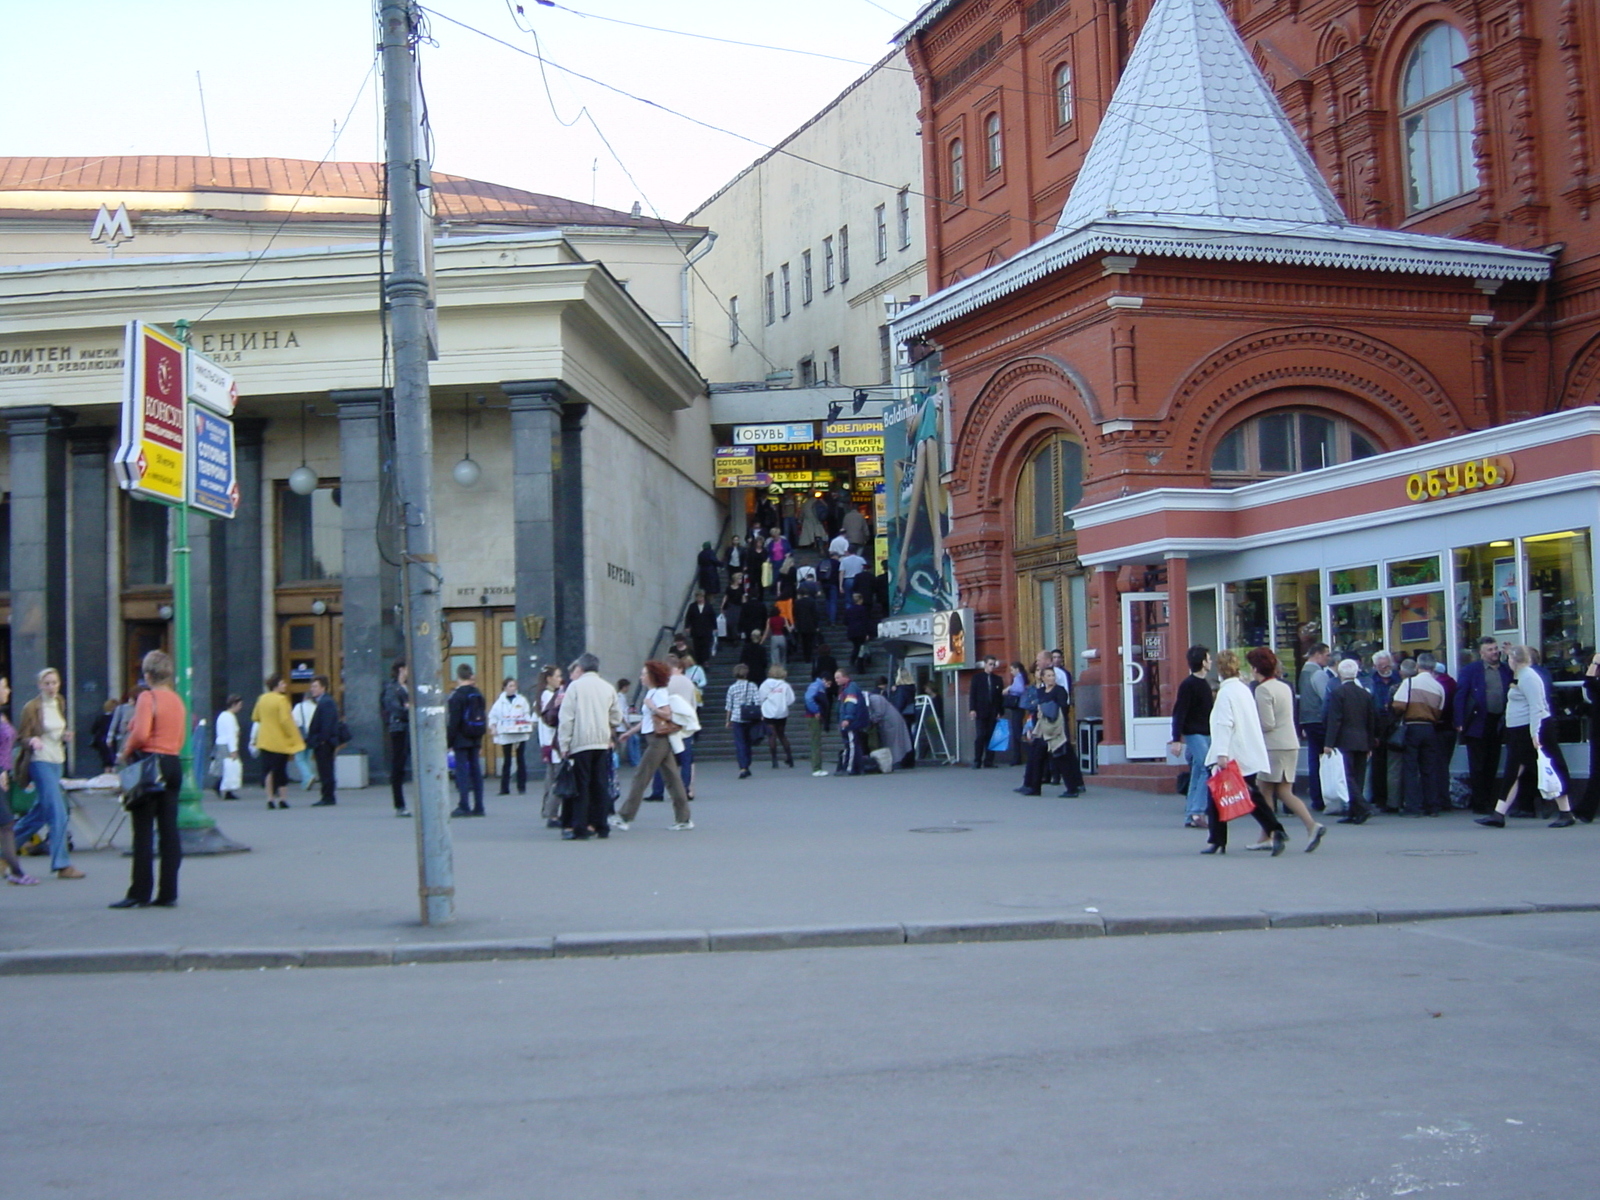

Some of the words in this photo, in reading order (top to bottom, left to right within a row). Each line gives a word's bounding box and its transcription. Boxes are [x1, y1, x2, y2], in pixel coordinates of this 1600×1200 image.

[79, 348, 119, 359] ИМЕНИ
[185, 330, 300, 353] ЕНИНА
[884, 397, 918, 428] Baldinini
[743, 429, 784, 440] ОБУВЬ
[843, 438, 881, 446] ОБМЕН
[717, 458, 753, 467] СОТОВАЯ
[717, 467, 744, 475] СВЯЗЬ
[1406, 457, 1498, 501] ОБУВЬ
[457, 587, 475, 595] НЕТ
[1220, 791, 1245, 807] West
